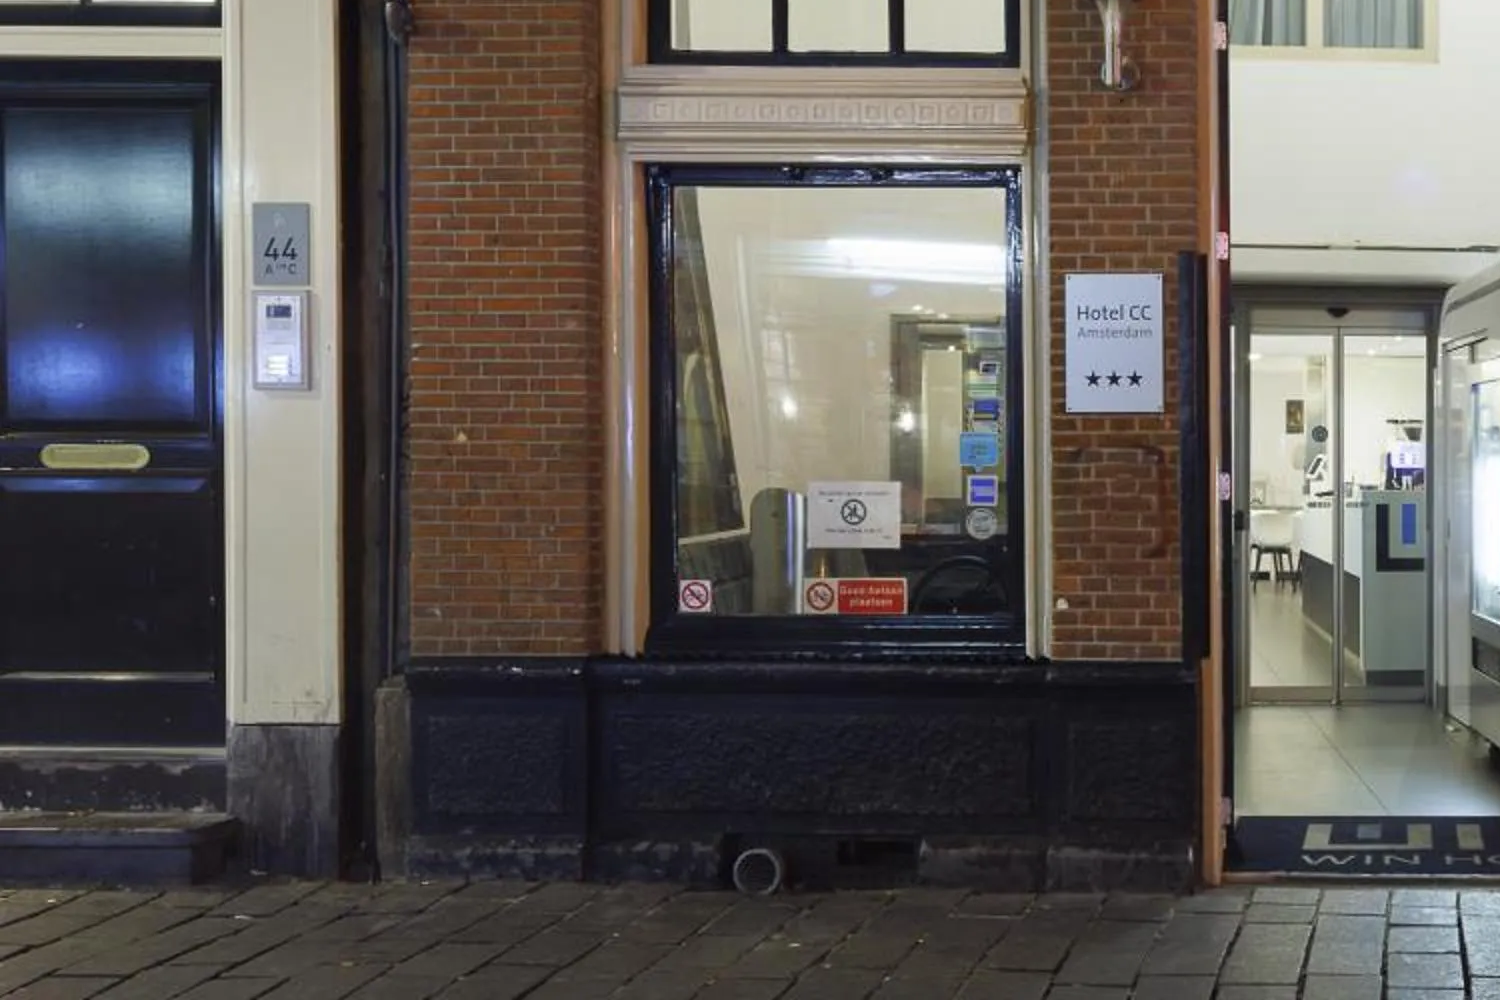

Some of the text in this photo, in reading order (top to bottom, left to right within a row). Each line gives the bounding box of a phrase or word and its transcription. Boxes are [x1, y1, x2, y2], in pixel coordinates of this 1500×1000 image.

[264, 236, 298, 262] 44
[1077, 304, 1152, 321] Hotel CC
[1077, 327, 1153, 339] Amsterdam
[1301, 855, 1420, 866] WIN
